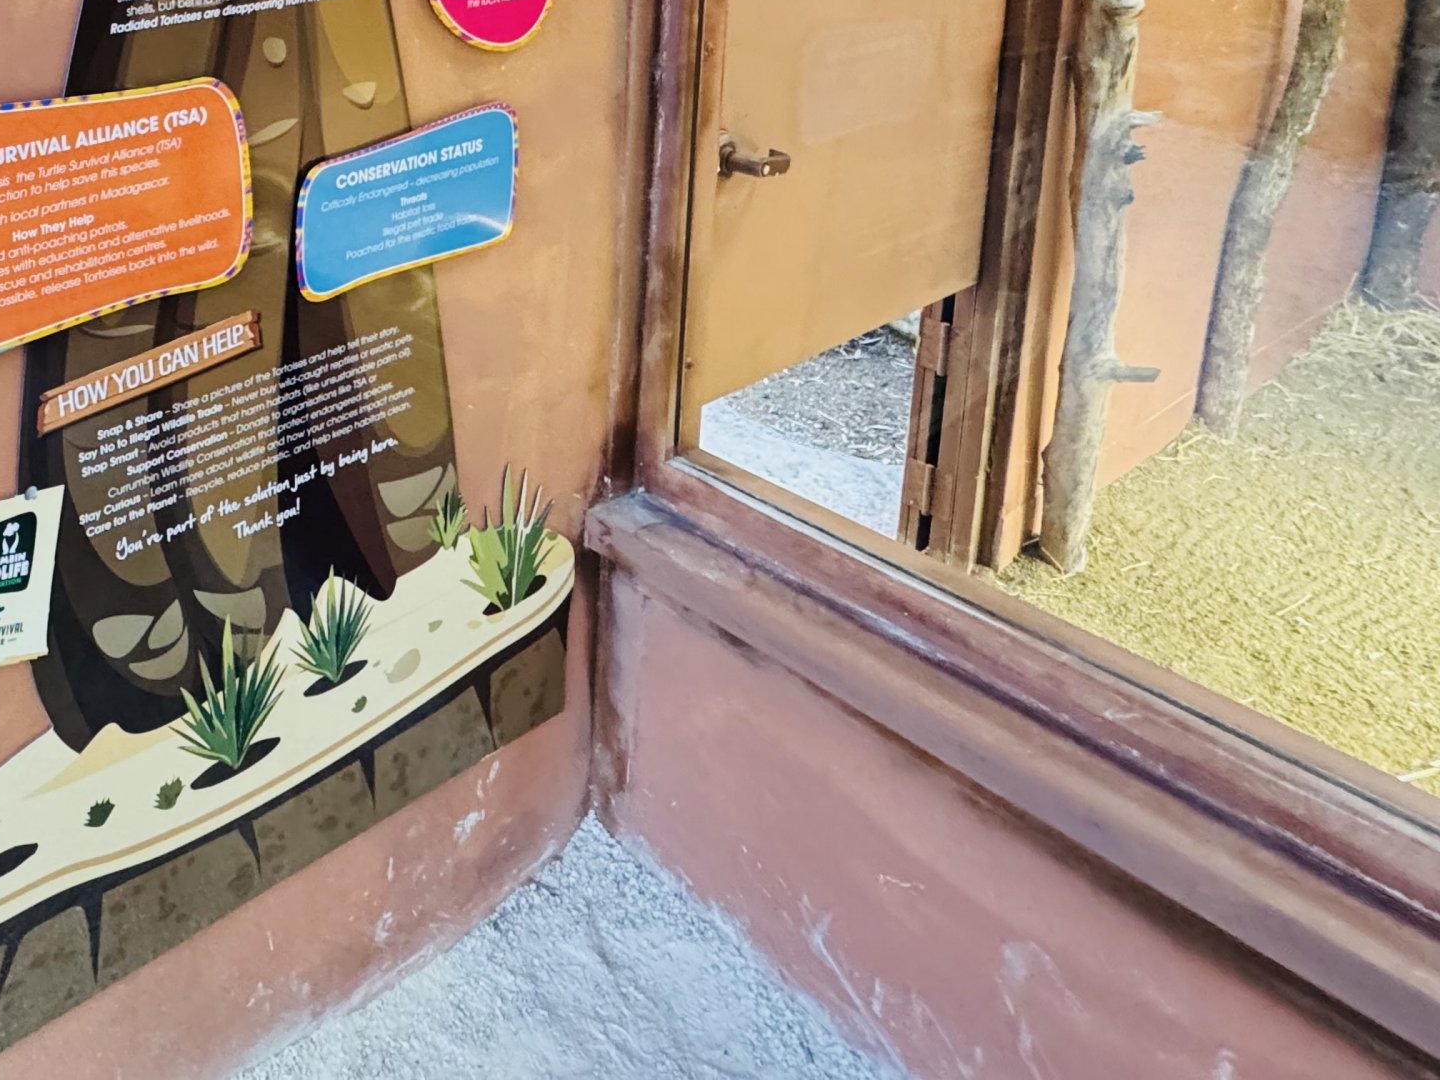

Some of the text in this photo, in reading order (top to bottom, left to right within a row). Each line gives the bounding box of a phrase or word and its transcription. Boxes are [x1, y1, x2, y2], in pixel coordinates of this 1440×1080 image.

[110, 16, 158, 35] Radiated
[160, 12, 201, 27] Tortoises
[203, 9, 220, 19] are
[158, 0, 175, 12] but
[75, 115, 158, 150] ALLIANCE
[163, 104, 207, 135] (TSA)
[15, 171, 35, 185] the
[38, 164, 66, 180] Turtle
[69, 153, 109, 174] Survival
[111, 147, 153, 165] Alliance
[156, 138, 181, 158] (TSA)
[30, 183, 41, 196] to
[44, 177, 69, 193] help
[72, 173, 97, 187] save
[100, 166, 117, 181] this
[335, 139, 482, 189] CONSERVATION STATUS
[10, 204, 38, 223] local
[41, 196, 86, 219] partners
[89, 192, 98, 205] in
[12, 212, 94, 242] How They Help
[8, 230, 87, 258] anti-poaching
[12, 255, 35, 273] with
[38, 243, 95, 266] education
[98, 233, 120, 251] and
[122, 222, 176, 245] alternative
[29, 266, 51, 284] and
[54, 250, 124, 277] rehabilitation
[41, 276, 80, 296] release
[83, 264, 126, 284] Tortoises
[129, 252, 155, 271] back
[157, 248, 176, 264] into
[179, 244, 194, 258] the
[58, 324, 244, 417] HOW YOU CAN HELP
[115, 437, 398, 560] You're part of the solution just by being here.
[233, 498, 300, 540] Thank you!
